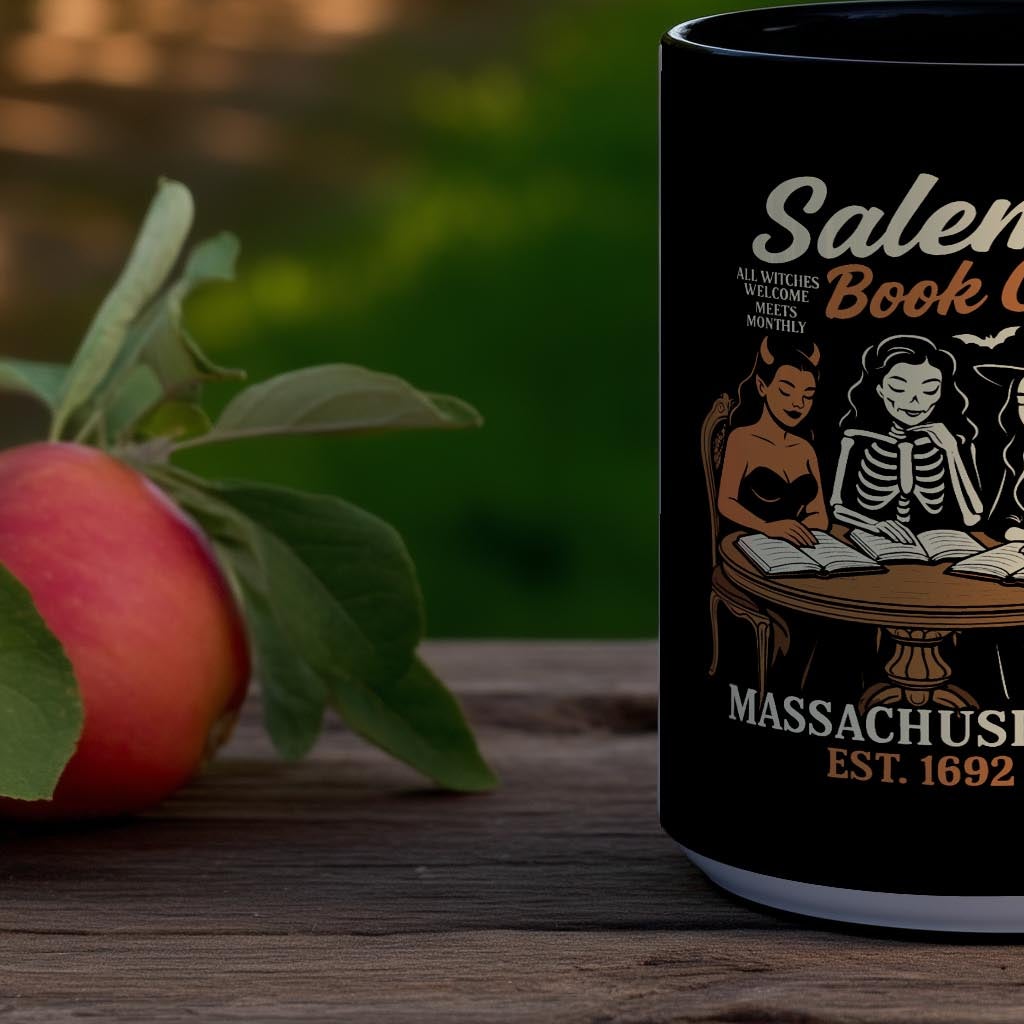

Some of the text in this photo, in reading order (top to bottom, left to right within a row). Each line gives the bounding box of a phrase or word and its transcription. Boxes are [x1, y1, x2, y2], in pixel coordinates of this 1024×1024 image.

[736, 266, 820, 290] ALL WITCHES
[743, 282, 810, 303] WELCOME
[825, 260, 989, 320] Book
[755, 301, 798, 319] MEETS
[746, 315, 807, 335] MONTHLY
[827, 747, 1015, 787] EST. 1692
